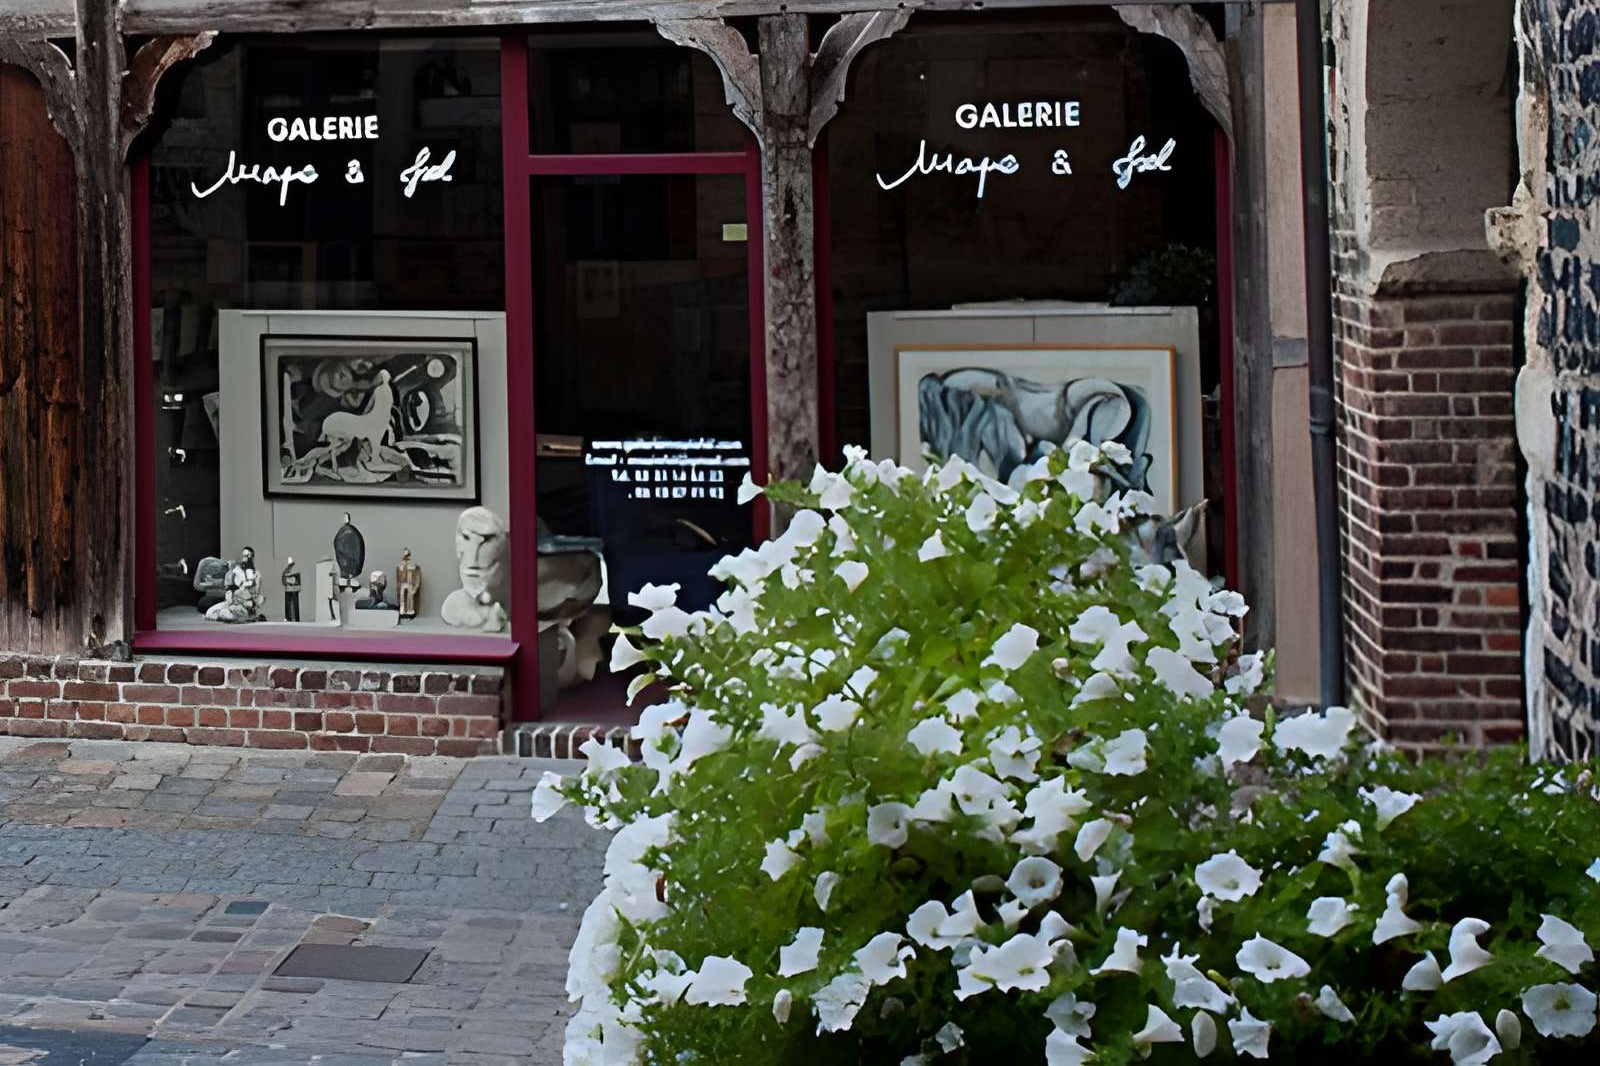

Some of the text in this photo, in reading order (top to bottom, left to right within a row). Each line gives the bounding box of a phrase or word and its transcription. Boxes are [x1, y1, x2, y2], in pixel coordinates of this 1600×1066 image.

[267, 114, 380, 142] GALERIE
[955, 101, 1080, 129] GALERIE
[344, 158, 365, 184] &
[1051, 149, 1073, 175] &
